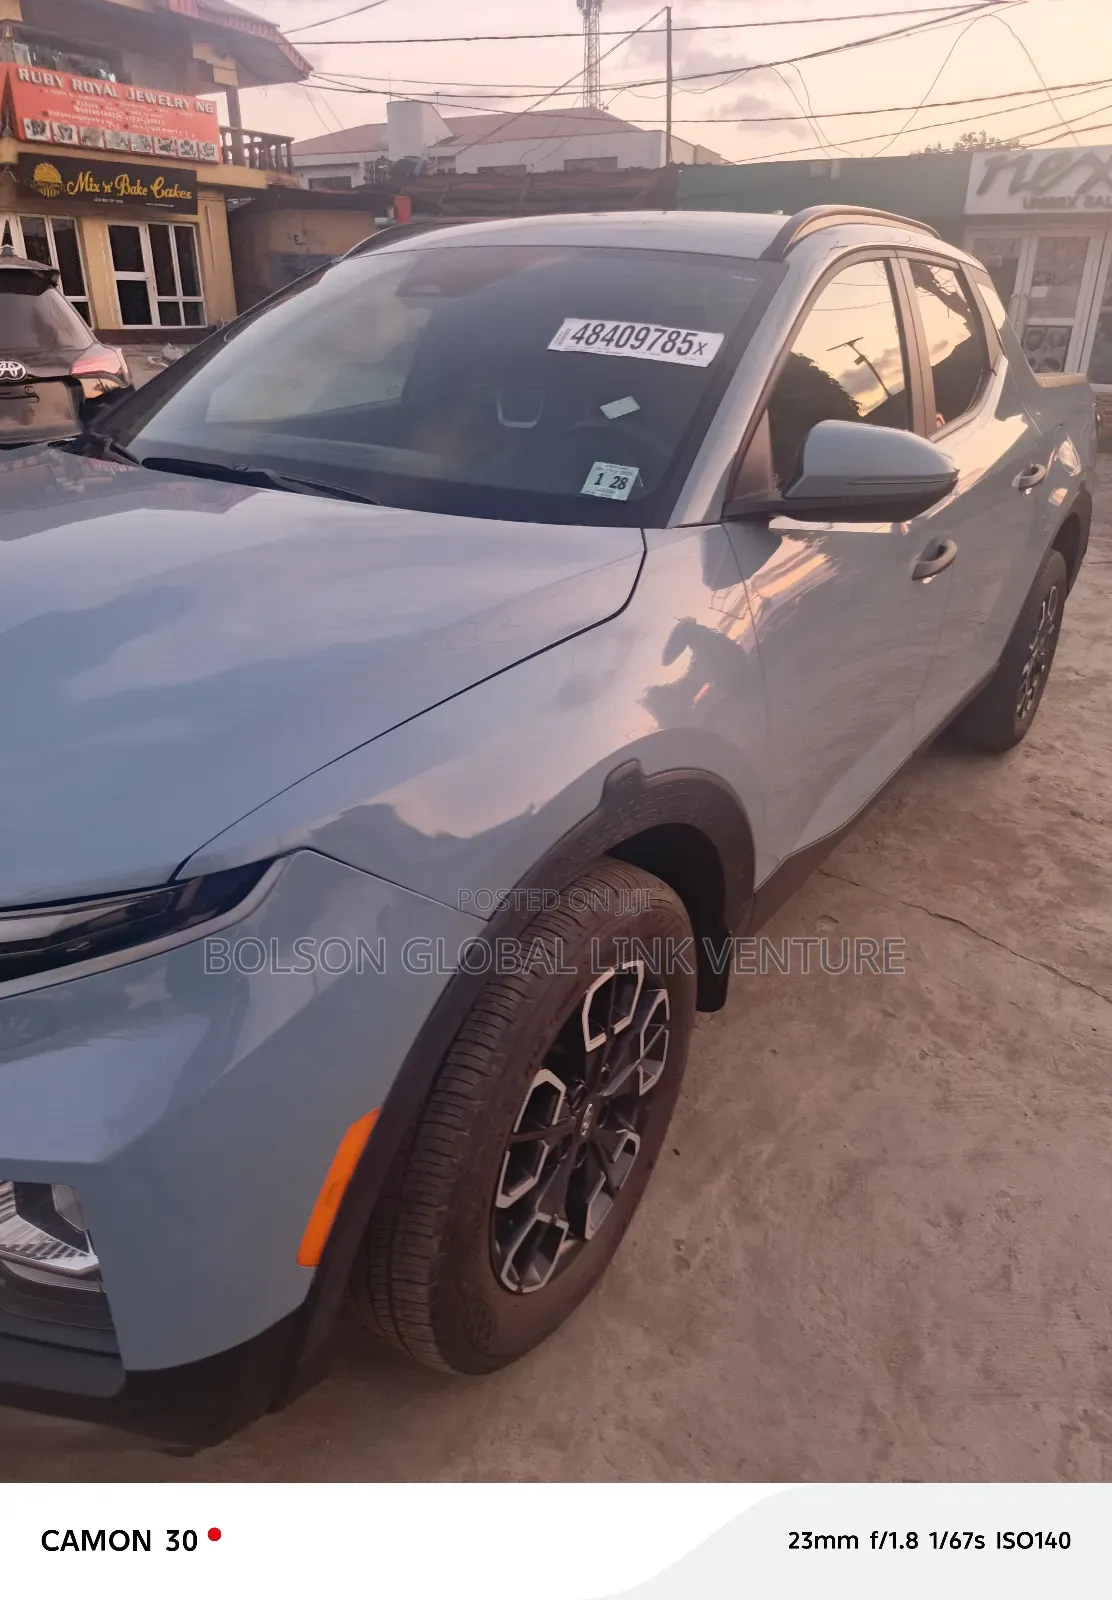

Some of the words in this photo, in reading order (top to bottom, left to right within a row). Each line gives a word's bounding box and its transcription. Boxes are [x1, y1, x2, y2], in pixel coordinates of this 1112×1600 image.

[18, 67, 65, 89] RUBY
[71, 78, 120, 99] ROYAL
[127, 87, 191, 110] JEWELRY
[66, 170, 100, 195] Mix
[115, 173, 148, 197] Bake
[594, 472, 605, 486] 1
[609, 475, 629, 490] 28
